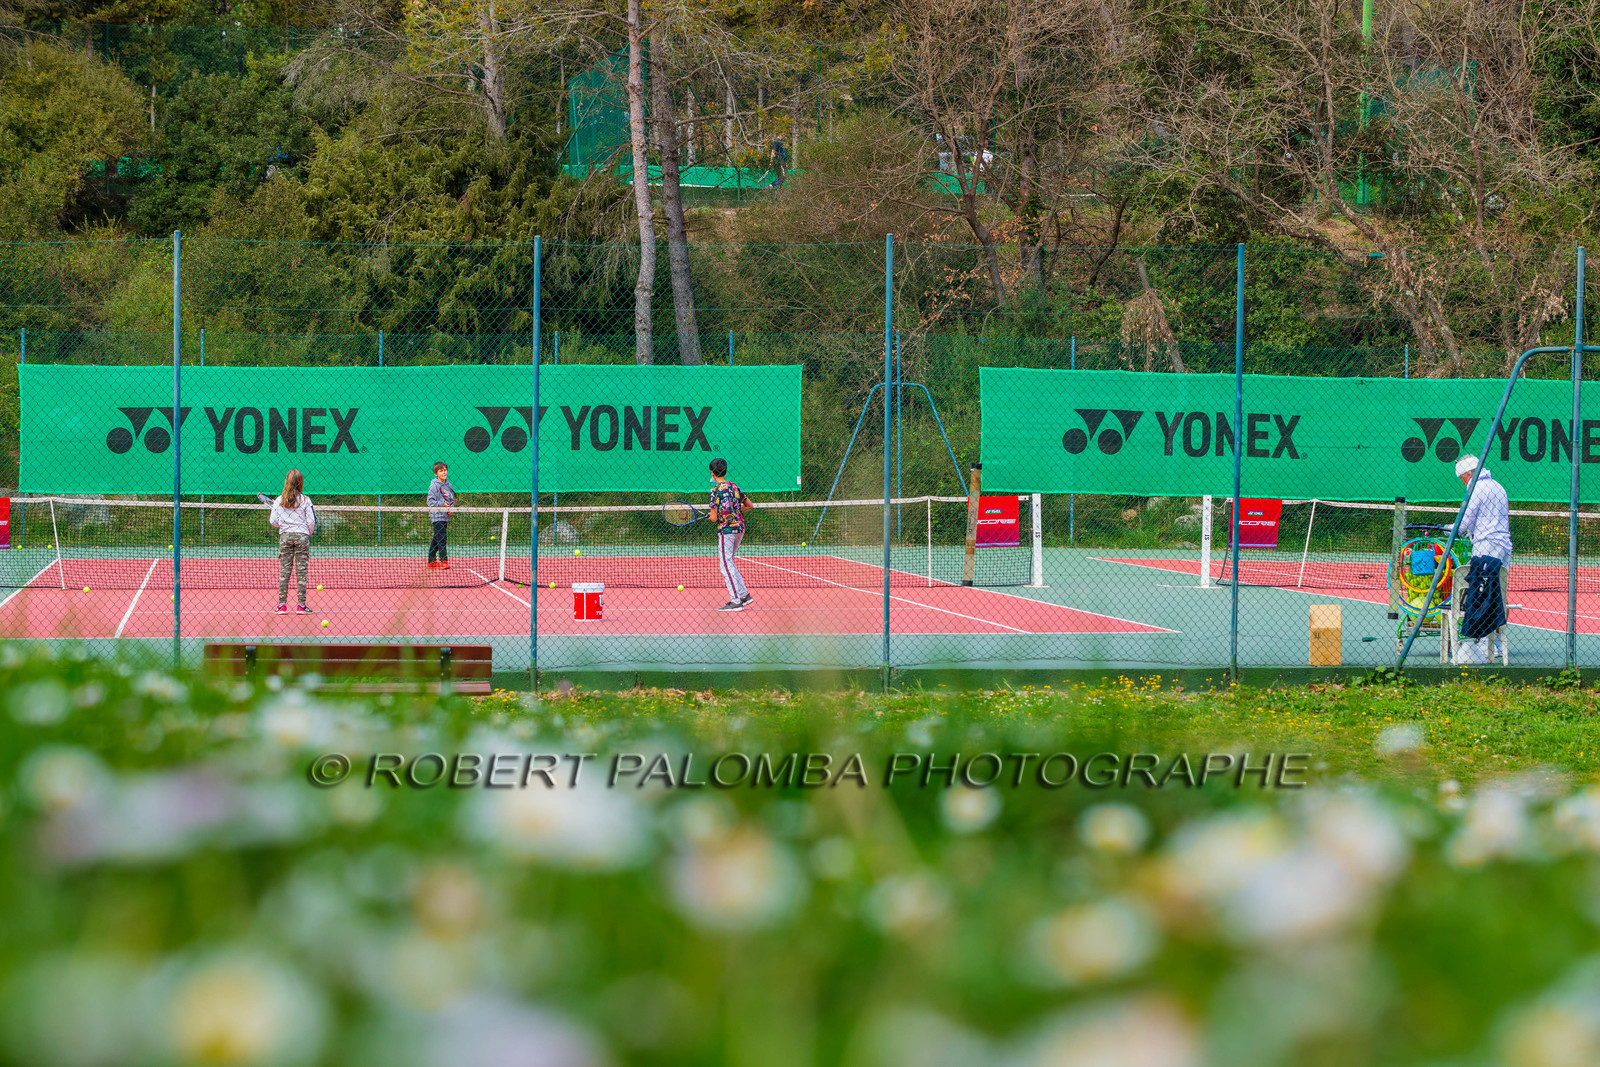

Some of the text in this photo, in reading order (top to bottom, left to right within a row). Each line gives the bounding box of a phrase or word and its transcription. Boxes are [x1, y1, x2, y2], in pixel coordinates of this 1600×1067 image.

[204, 407, 359, 454] YONEX
[560, 405, 712, 451] YONEX
[1155, 412, 1301, 459] YONEX
